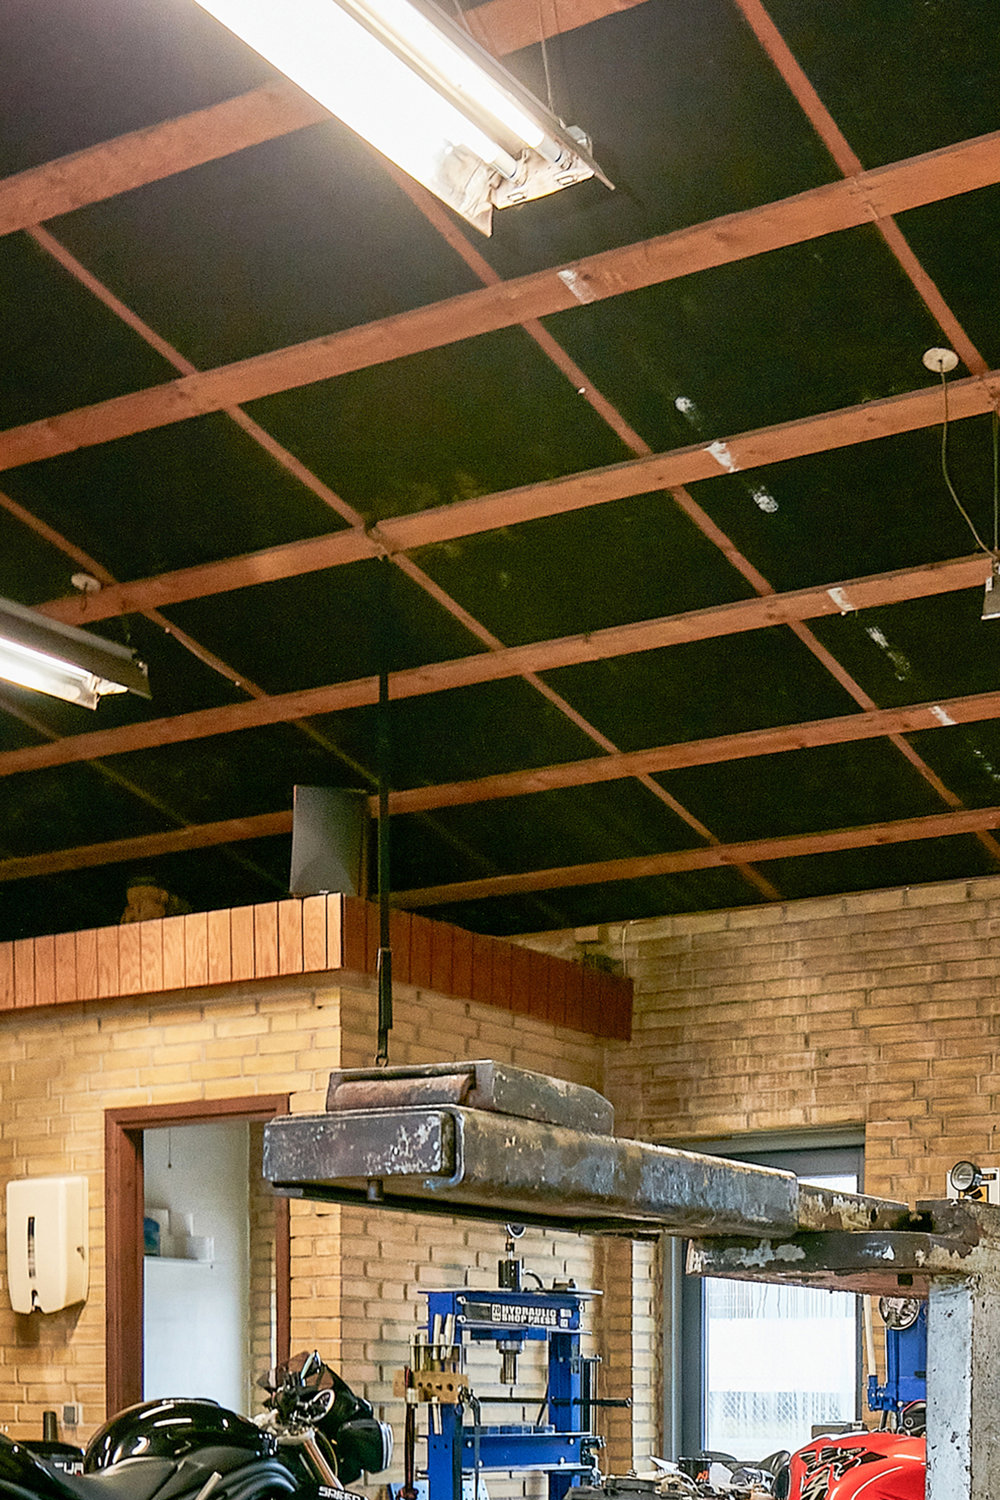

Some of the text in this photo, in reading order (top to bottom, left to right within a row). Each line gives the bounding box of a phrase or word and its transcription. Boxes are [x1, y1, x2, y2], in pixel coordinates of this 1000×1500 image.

[501, 1304, 557, 1318] HYDRAULIC
[501, 1313, 527, 1323] SHOP
[527, 1315, 557, 1326] PRESS
